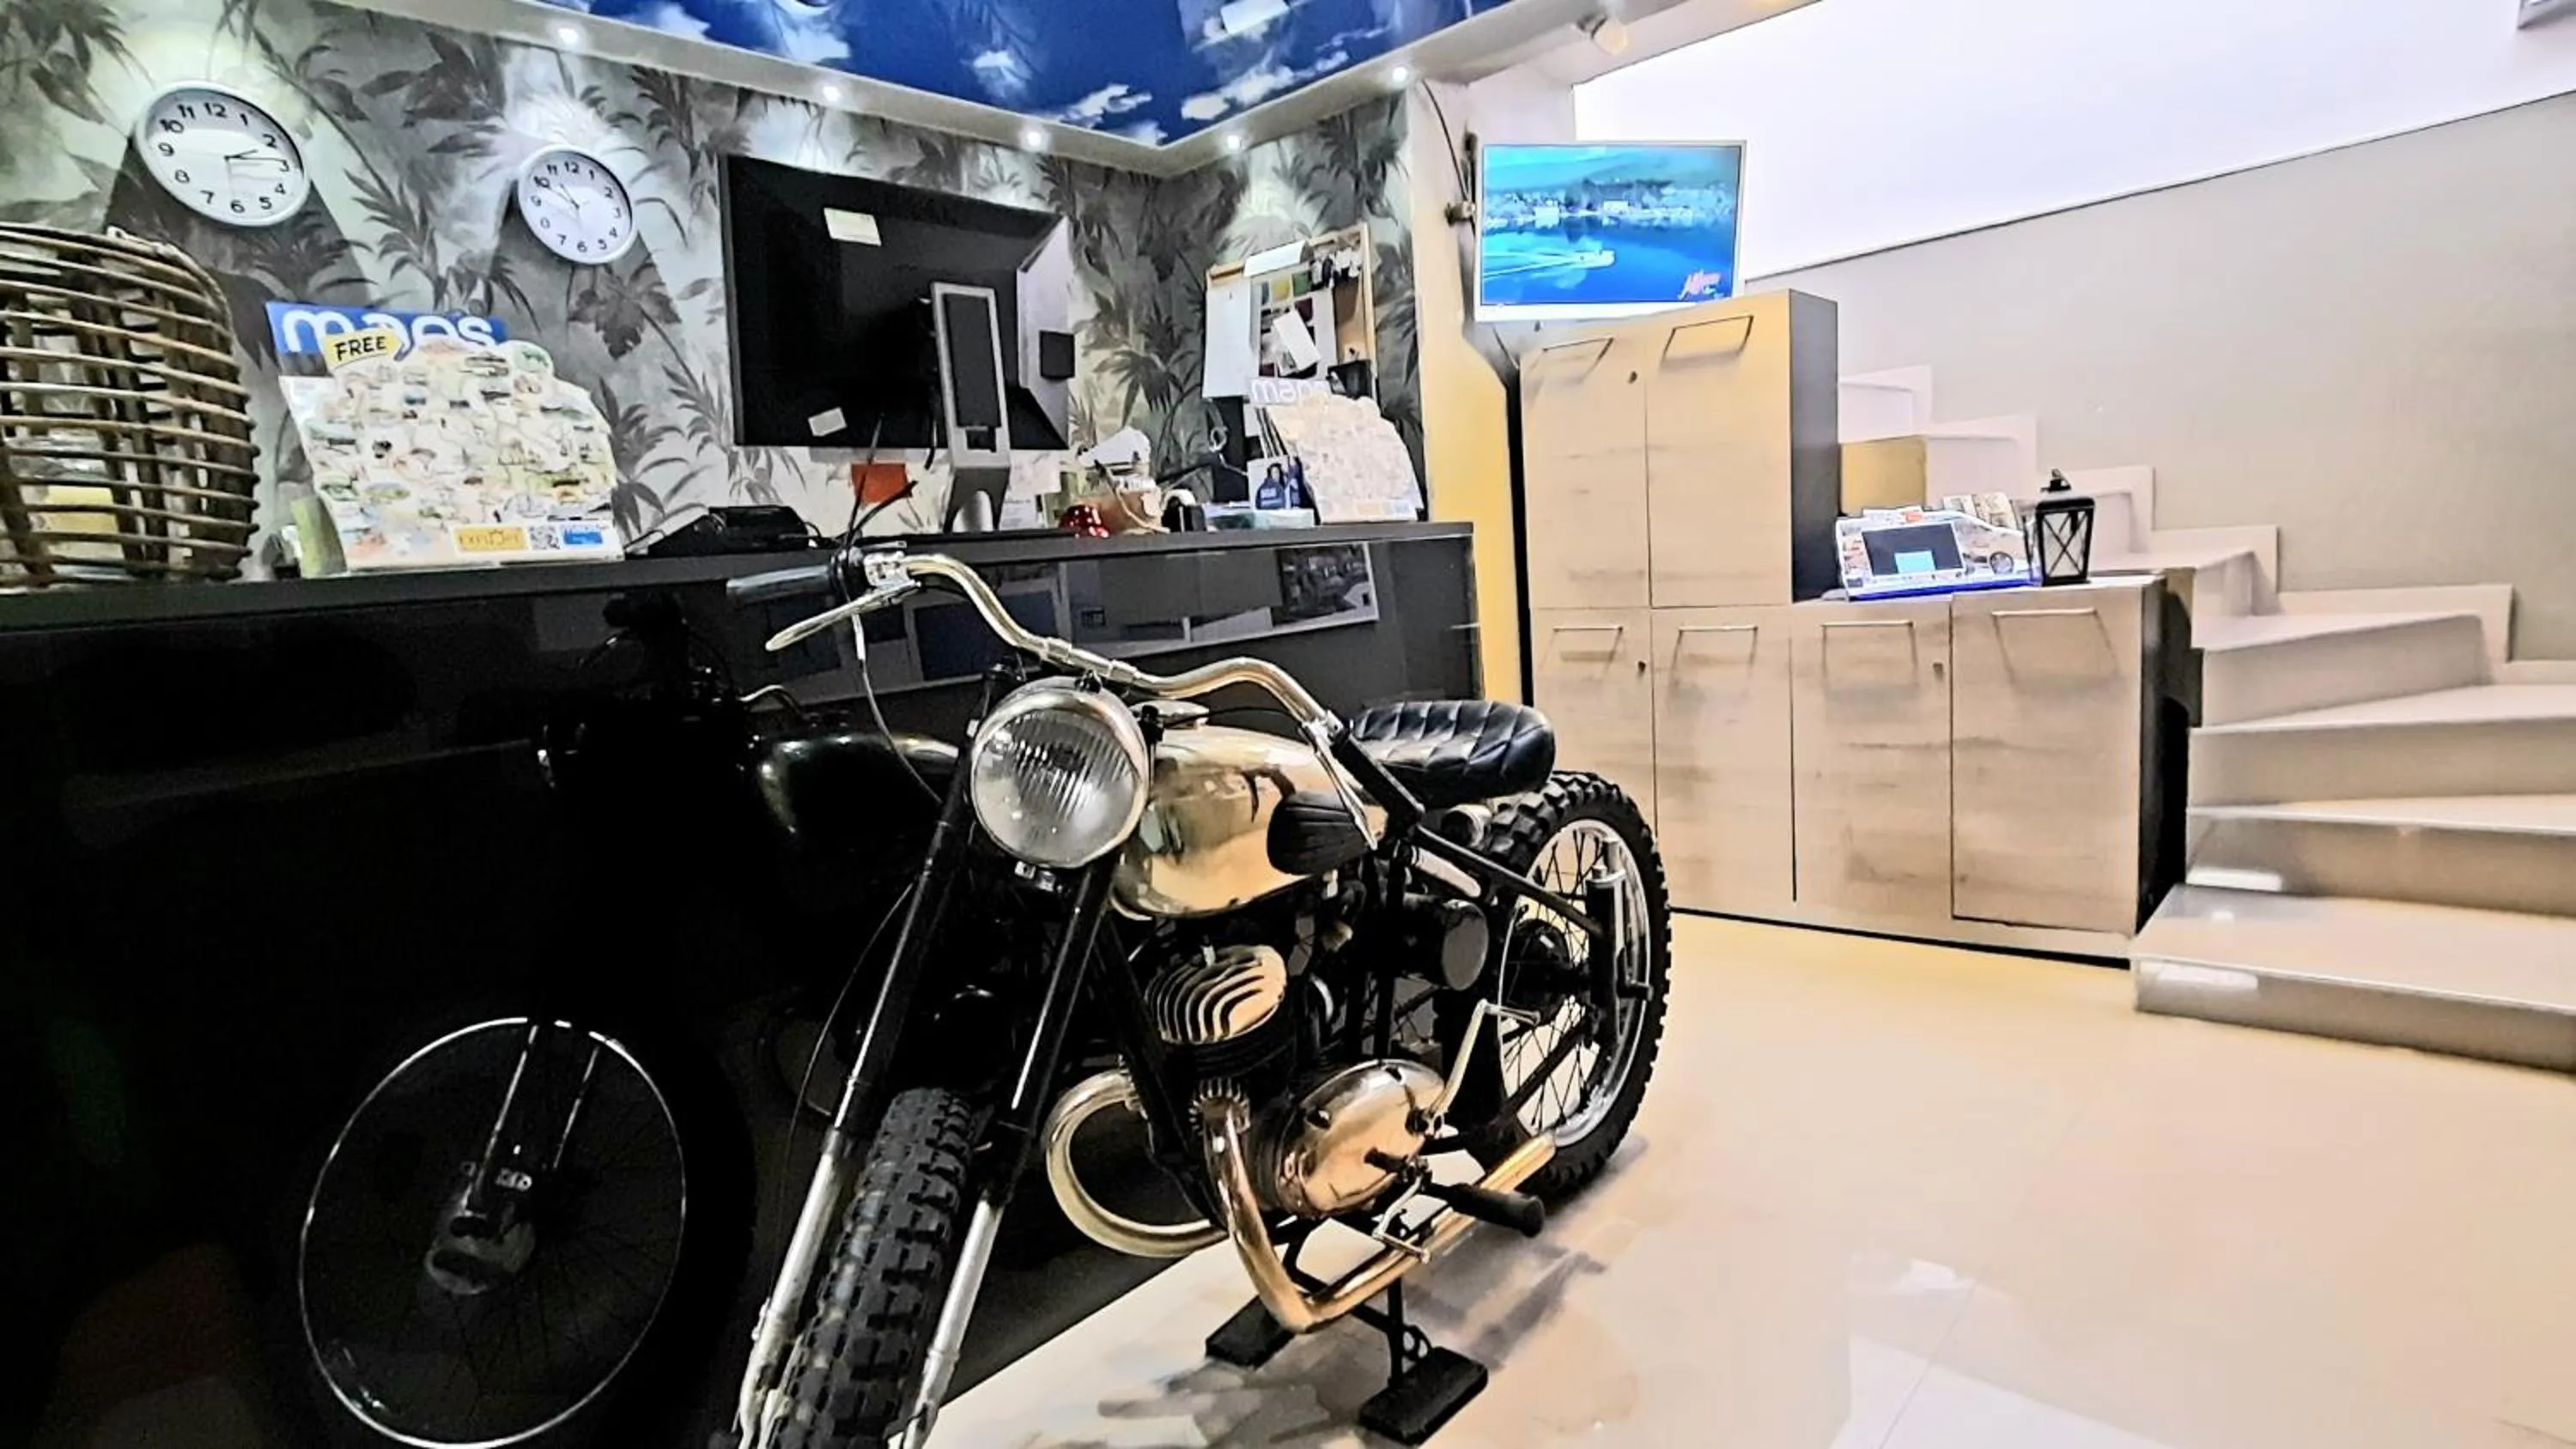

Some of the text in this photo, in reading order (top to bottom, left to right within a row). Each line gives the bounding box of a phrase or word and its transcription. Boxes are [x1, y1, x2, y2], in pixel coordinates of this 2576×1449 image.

[177, 104, 196, 118] 11
[204, 102, 227, 118] 12
[240, 113, 248, 125] 1
[159, 118, 185, 134] 10
[263, 134, 276, 149] 2
[158, 142, 174, 156] 9
[279, 160, 289, 173] 3
[547, 164, 558, 175] 11
[564, 161, 580, 173] 12
[174, 169, 190, 184] 8
[589, 169, 595, 179] 1
[534, 175, 550, 188] 10
[275, 183, 286, 195] 4
[605, 186, 613, 199] 2
[200, 190, 215, 204] 7
[258, 197, 272, 209] 5
[531, 195, 542, 207] 9
[230, 200, 245, 213] 6
[609, 227, 618, 238] 4
[556, 233, 567, 246] 7
[577, 241, 587, 253] 6
[335, 336, 387, 361] FREE
[1251, 379, 1327, 403] map
